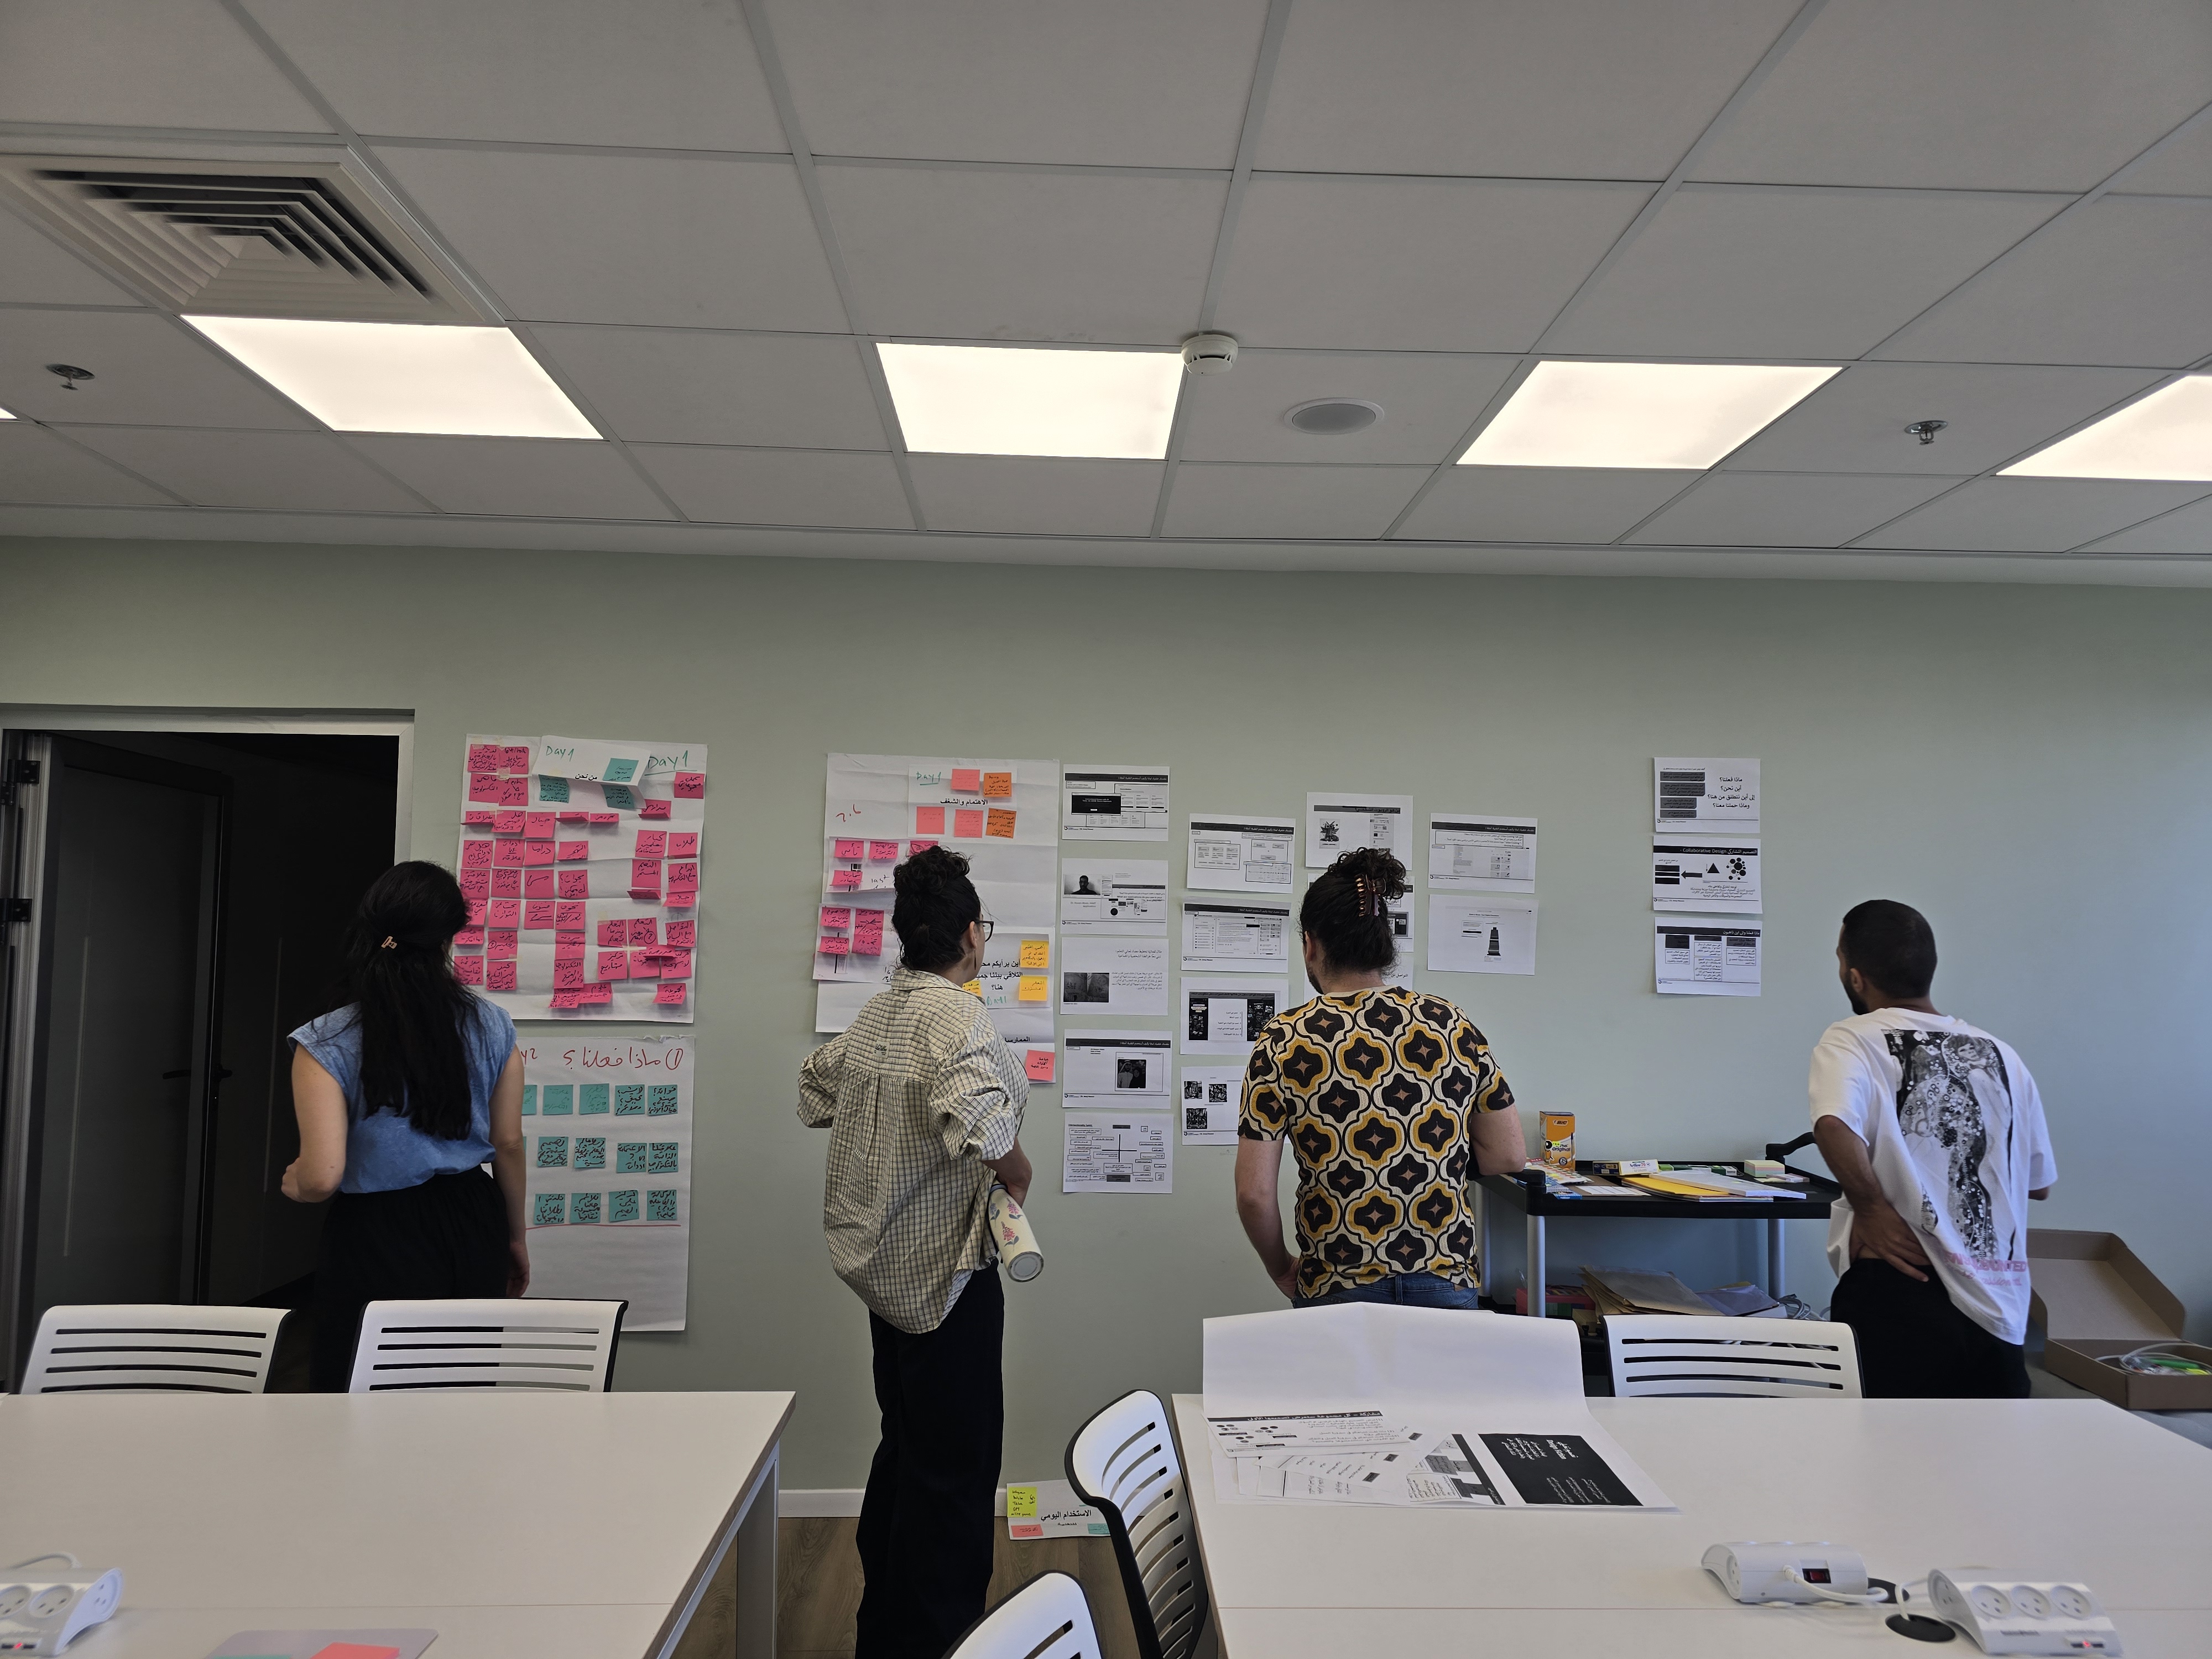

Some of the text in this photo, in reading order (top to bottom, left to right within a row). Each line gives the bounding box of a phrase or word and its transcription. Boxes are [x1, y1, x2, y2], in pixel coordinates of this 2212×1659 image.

[546, 746, 574, 762] Day 1
[648, 750, 688, 770] Day 1
[916, 771, 934, 782] Day
[532, 844, 551, 854] دراما
[676, 836, 695, 850] طلاب
[992, 959, 1010, 968] برأيكم
[1011, 959, 1021, 967] أين
[1004, 972, 1023, 980] التلاقي
[583, 1046, 623, 1067] فعلنا
[629, 1046, 661, 1068] ماذا
[1041, 1509, 1092, 1521] الاستخدام اليومي
